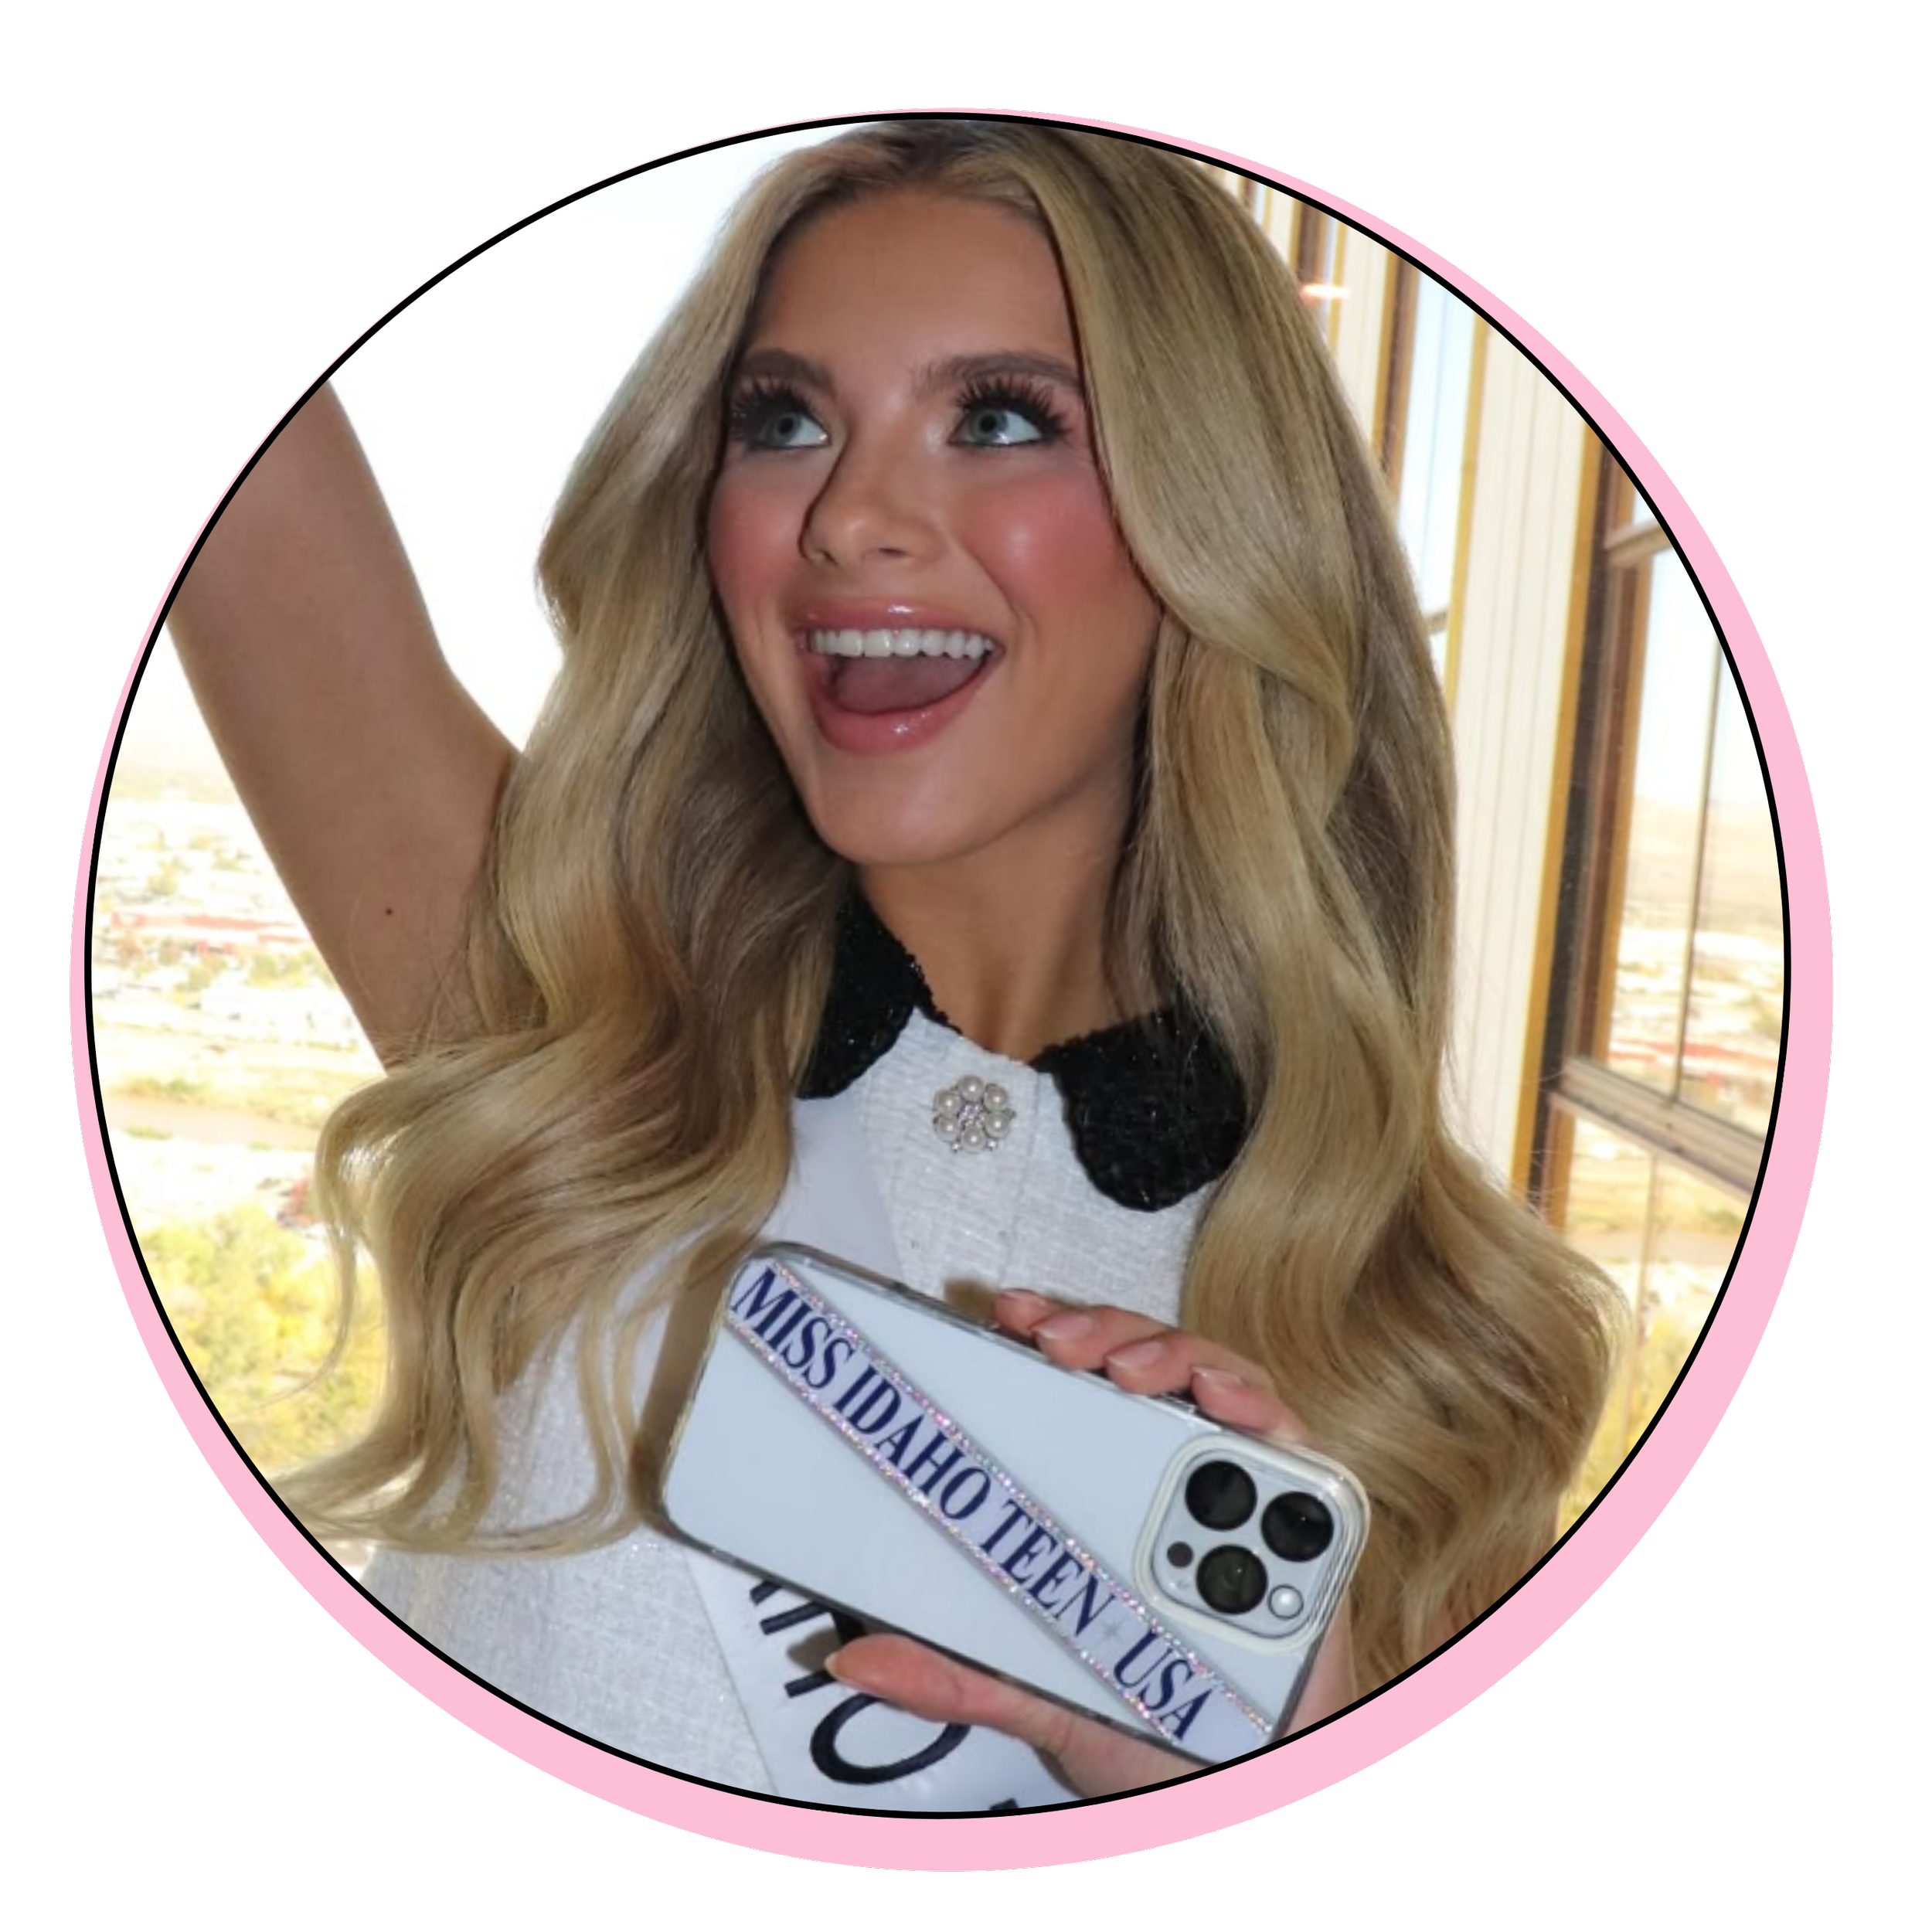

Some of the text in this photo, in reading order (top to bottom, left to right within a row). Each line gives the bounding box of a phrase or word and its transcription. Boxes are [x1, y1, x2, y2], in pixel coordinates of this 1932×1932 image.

[730, 1267, 856, 1389] MISS
[833, 1364, 992, 1520] IDAHO
[980, 1499, 1117, 1637] TEEN
[1114, 1628, 1213, 1740] USA
